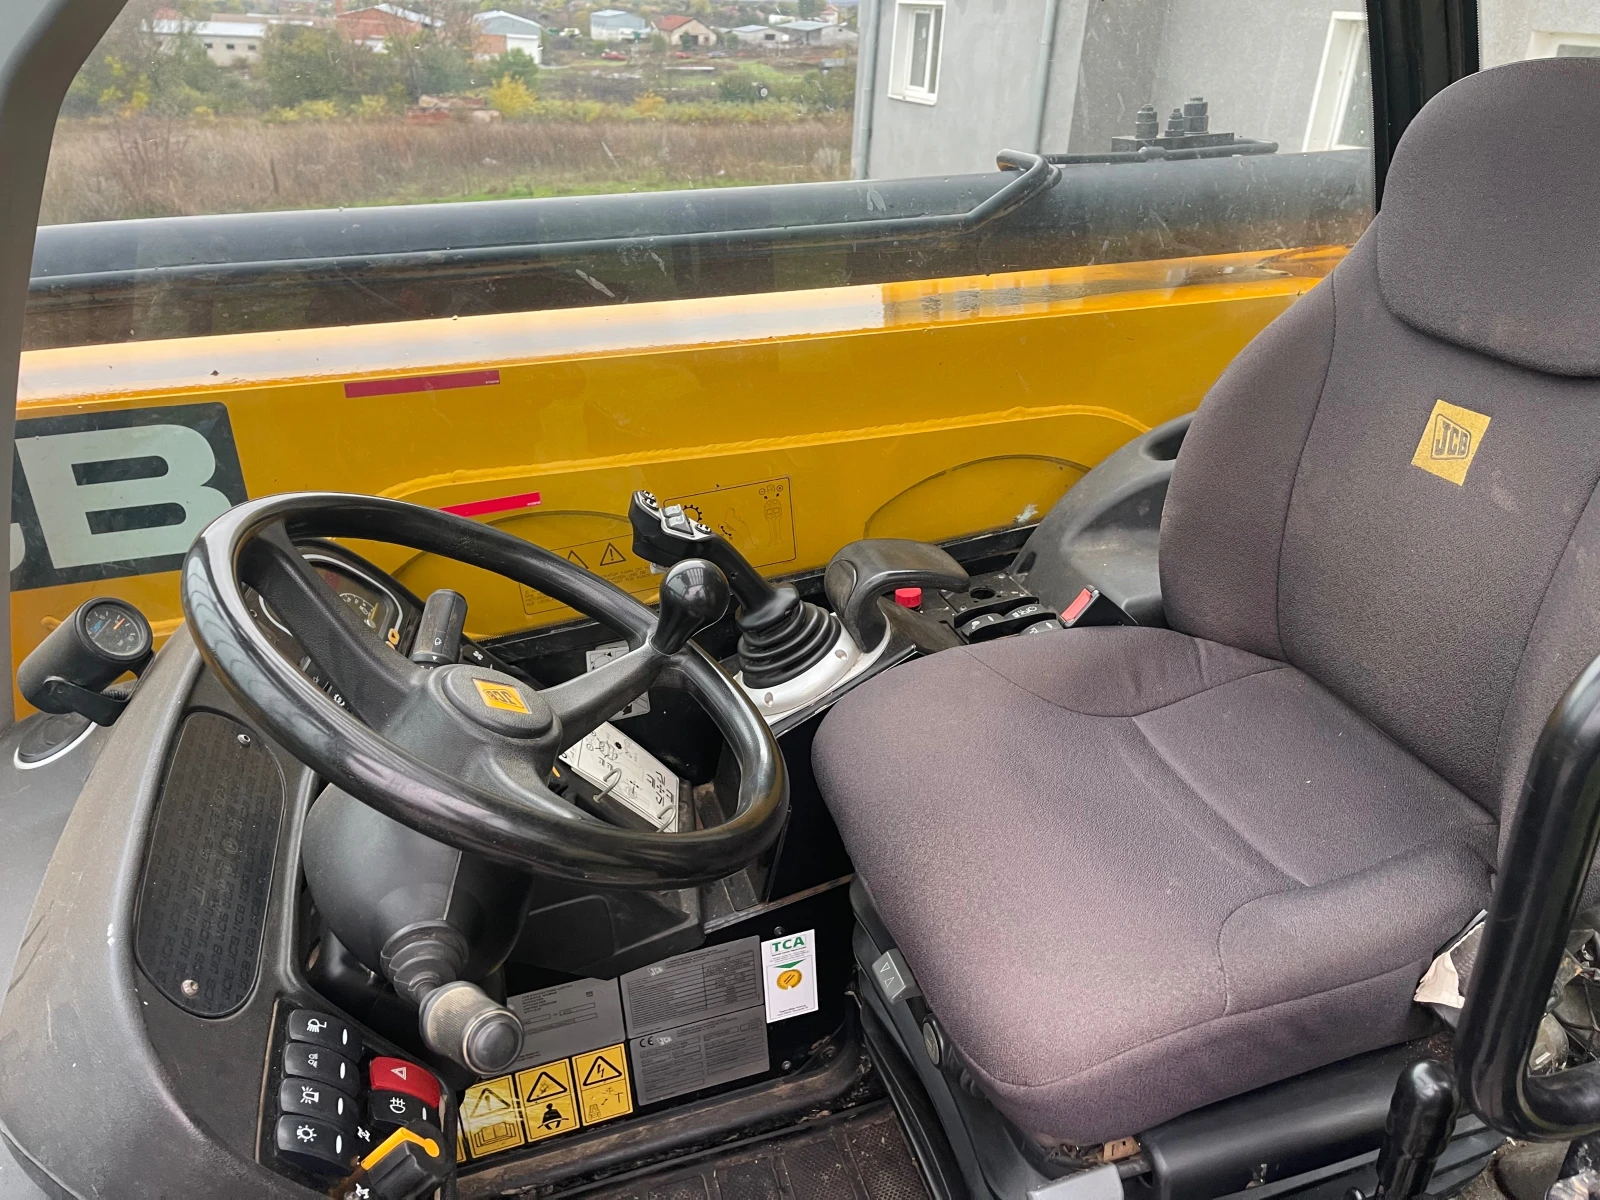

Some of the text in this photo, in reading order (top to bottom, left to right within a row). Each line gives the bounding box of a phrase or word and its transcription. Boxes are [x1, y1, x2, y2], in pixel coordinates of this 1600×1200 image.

[1434, 420, 1469, 456] JCB
[486, 690, 516, 705] JCB
[771, 935, 805, 952] TCA
[237, 959, 251, 989] JCB
